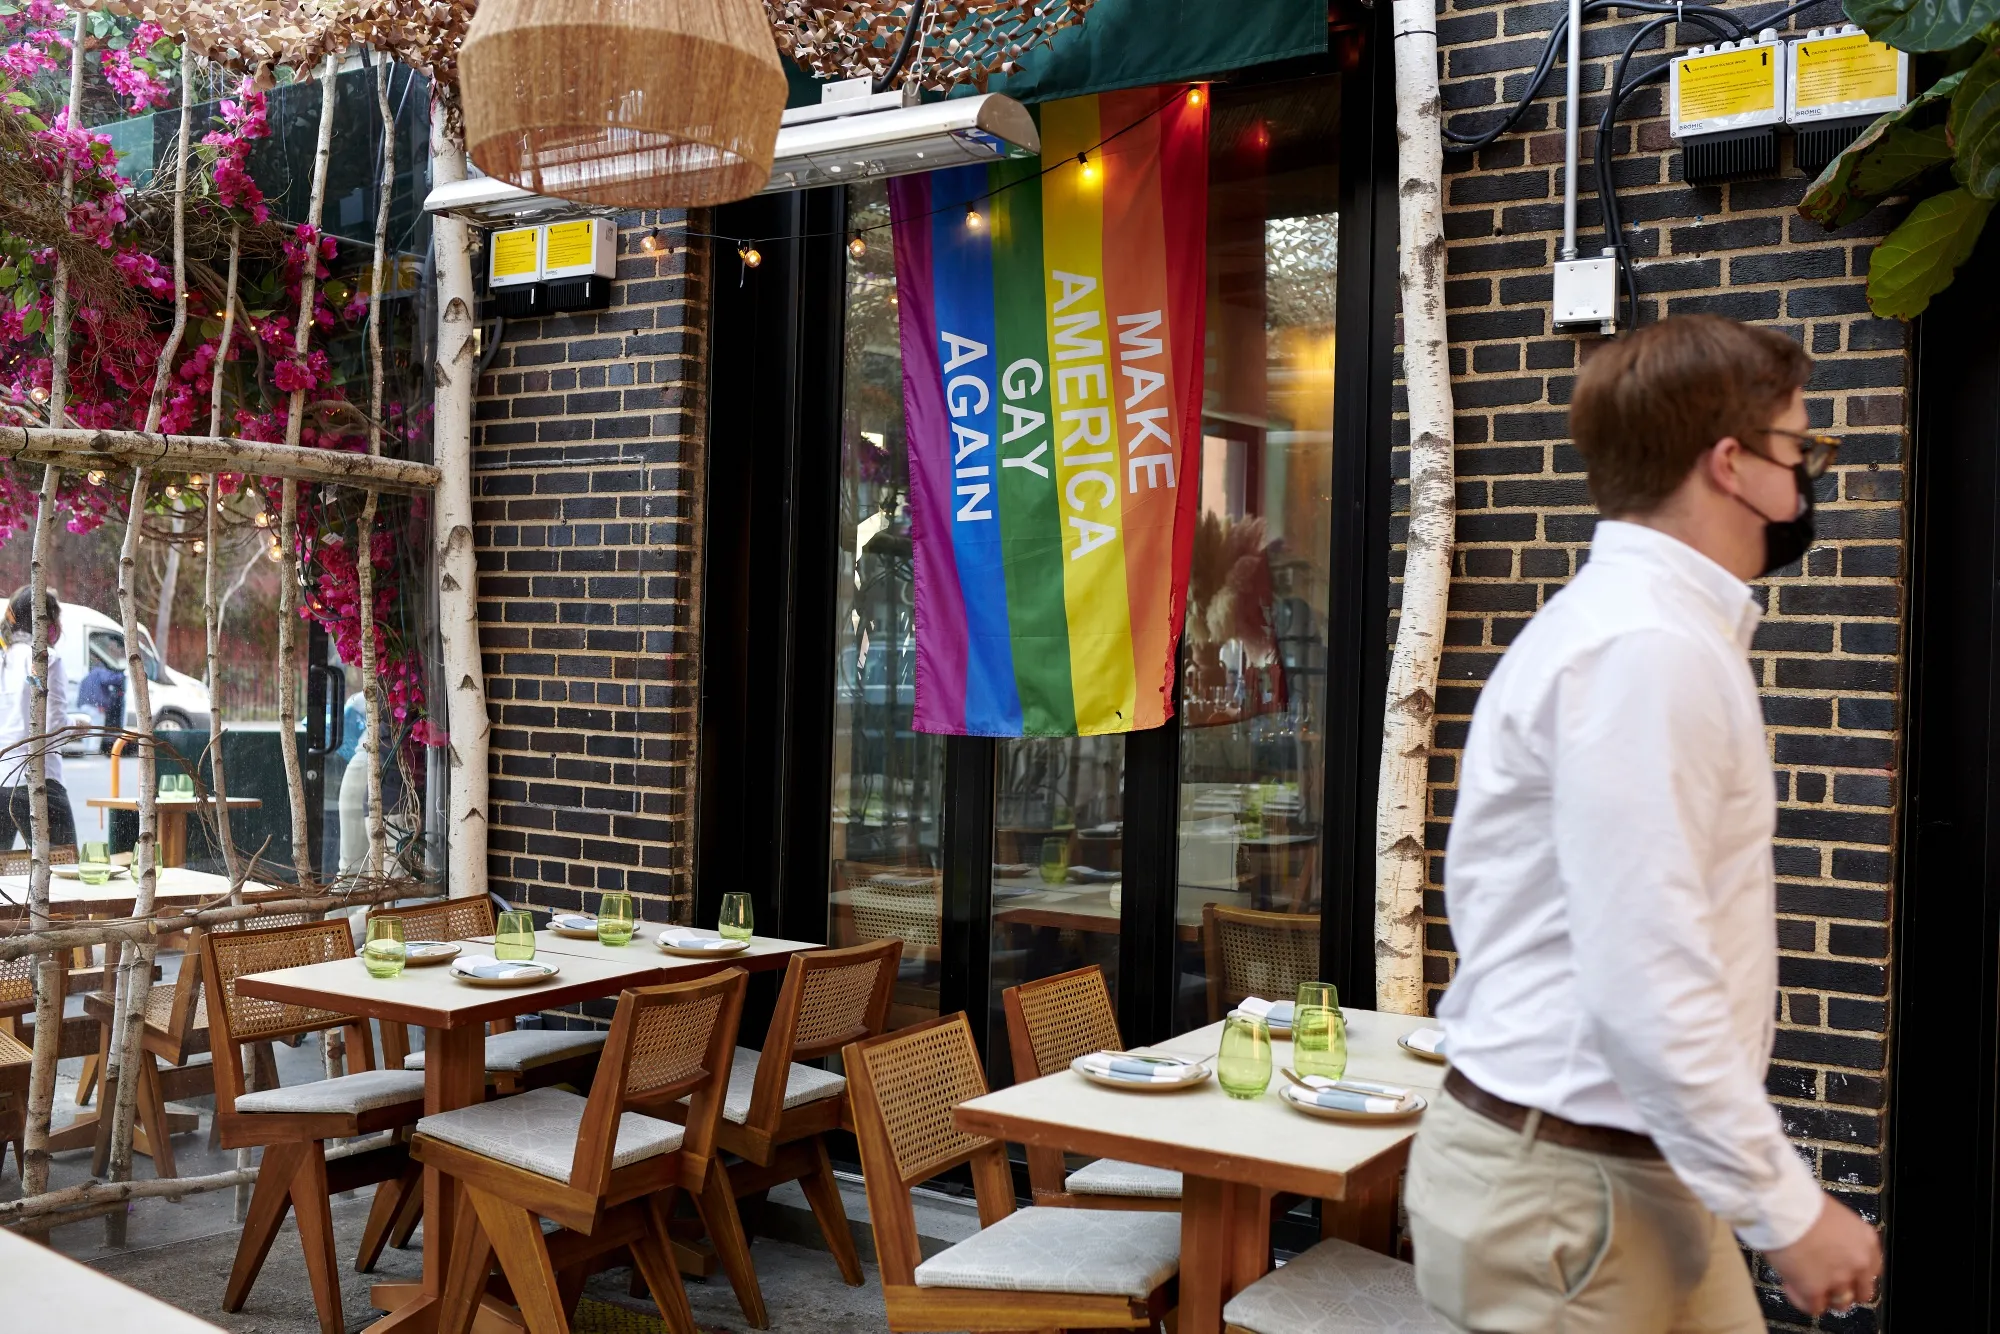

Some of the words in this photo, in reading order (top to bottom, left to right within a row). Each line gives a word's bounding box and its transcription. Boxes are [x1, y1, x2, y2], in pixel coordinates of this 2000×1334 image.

[1679, 122, 1703, 130] BROMIC
[1796, 108, 1821, 116] BROMIC
[941, 330, 992, 522] AGAIN
[1001, 358, 1049, 479] GAY
[1052, 269, 1117, 561] AMERICA
[1116, 309, 1176, 494] MAKE
